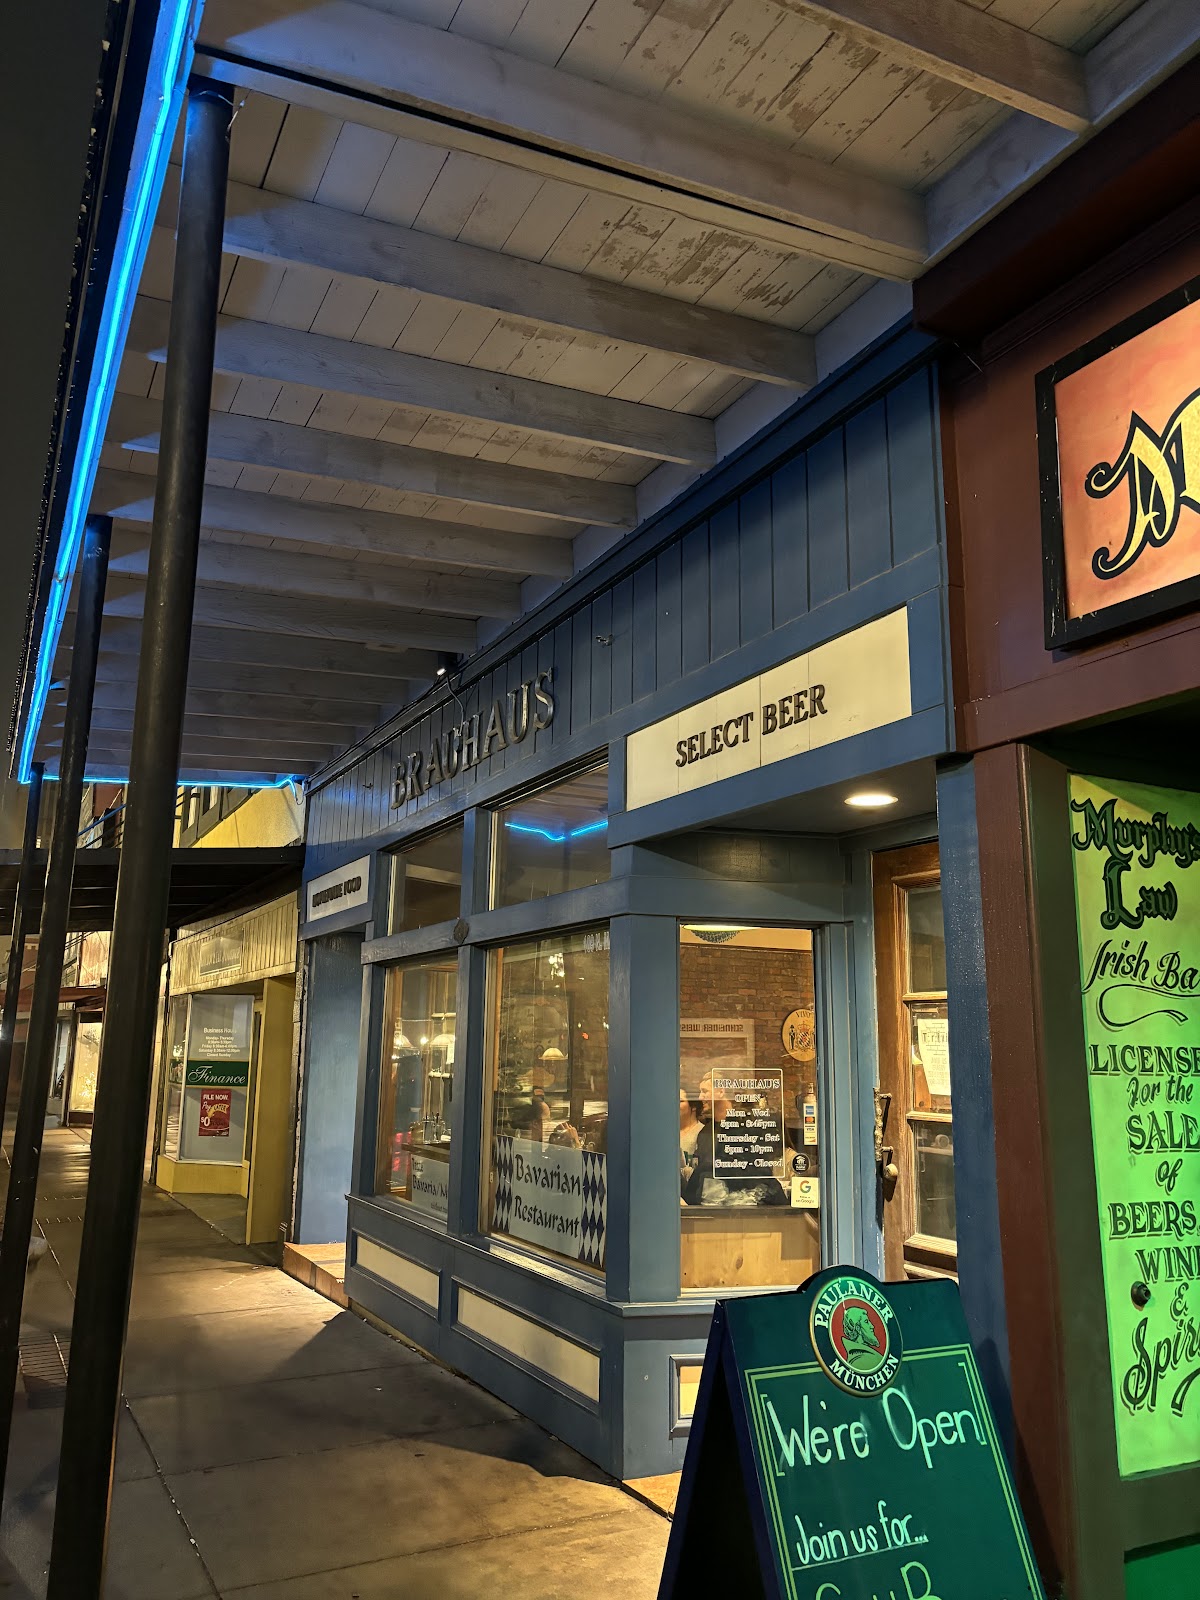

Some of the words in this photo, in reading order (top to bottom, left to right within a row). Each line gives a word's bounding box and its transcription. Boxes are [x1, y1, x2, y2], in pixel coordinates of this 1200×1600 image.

[391, 667, 554, 810] BRAUHAUS
[675, 711, 754, 767] SELECT
[761, 684, 828, 735] BEER
[1100, 857, 1178, 930] Law
[1082, 939, 1149, 993] Irish
[187, 1065, 246, 1084] Finance
[714, 1078, 780, 1089] BRAUHAUS
[1166, 1075, 1194, 1105] the
[726, 1108, 746, 1117] Mon
[734, 1093, 761, 1103] OPEN
[717, 1133, 758, 1143] Thursday
[764, 1133, 780, 1142] Sat
[720, 1119, 739, 1130] 5pm
[1127, 1110, 1200, 1154] SALE
[714, 1159, 748, 1169] Sunday
[724, 1144, 744, 1155] 5pm
[515, 1153, 581, 1197] Bavarian
[800, 1180, 811, 1194] G
[1156, 1158, 1183, 1195] of
[514, 1195, 580, 1239] Restaurant
[814, 1278, 894, 1329] PAULANER
[829, 1353, 899, 1391] MÜNCHEN
[1120, 1316, 1200, 1416] Spir
[766, 1395, 870, 1468] We're
[882, 1387, 981, 1469] Open
[794, 1514, 848, 1565] Join
[850, 1523, 879, 1554] us
